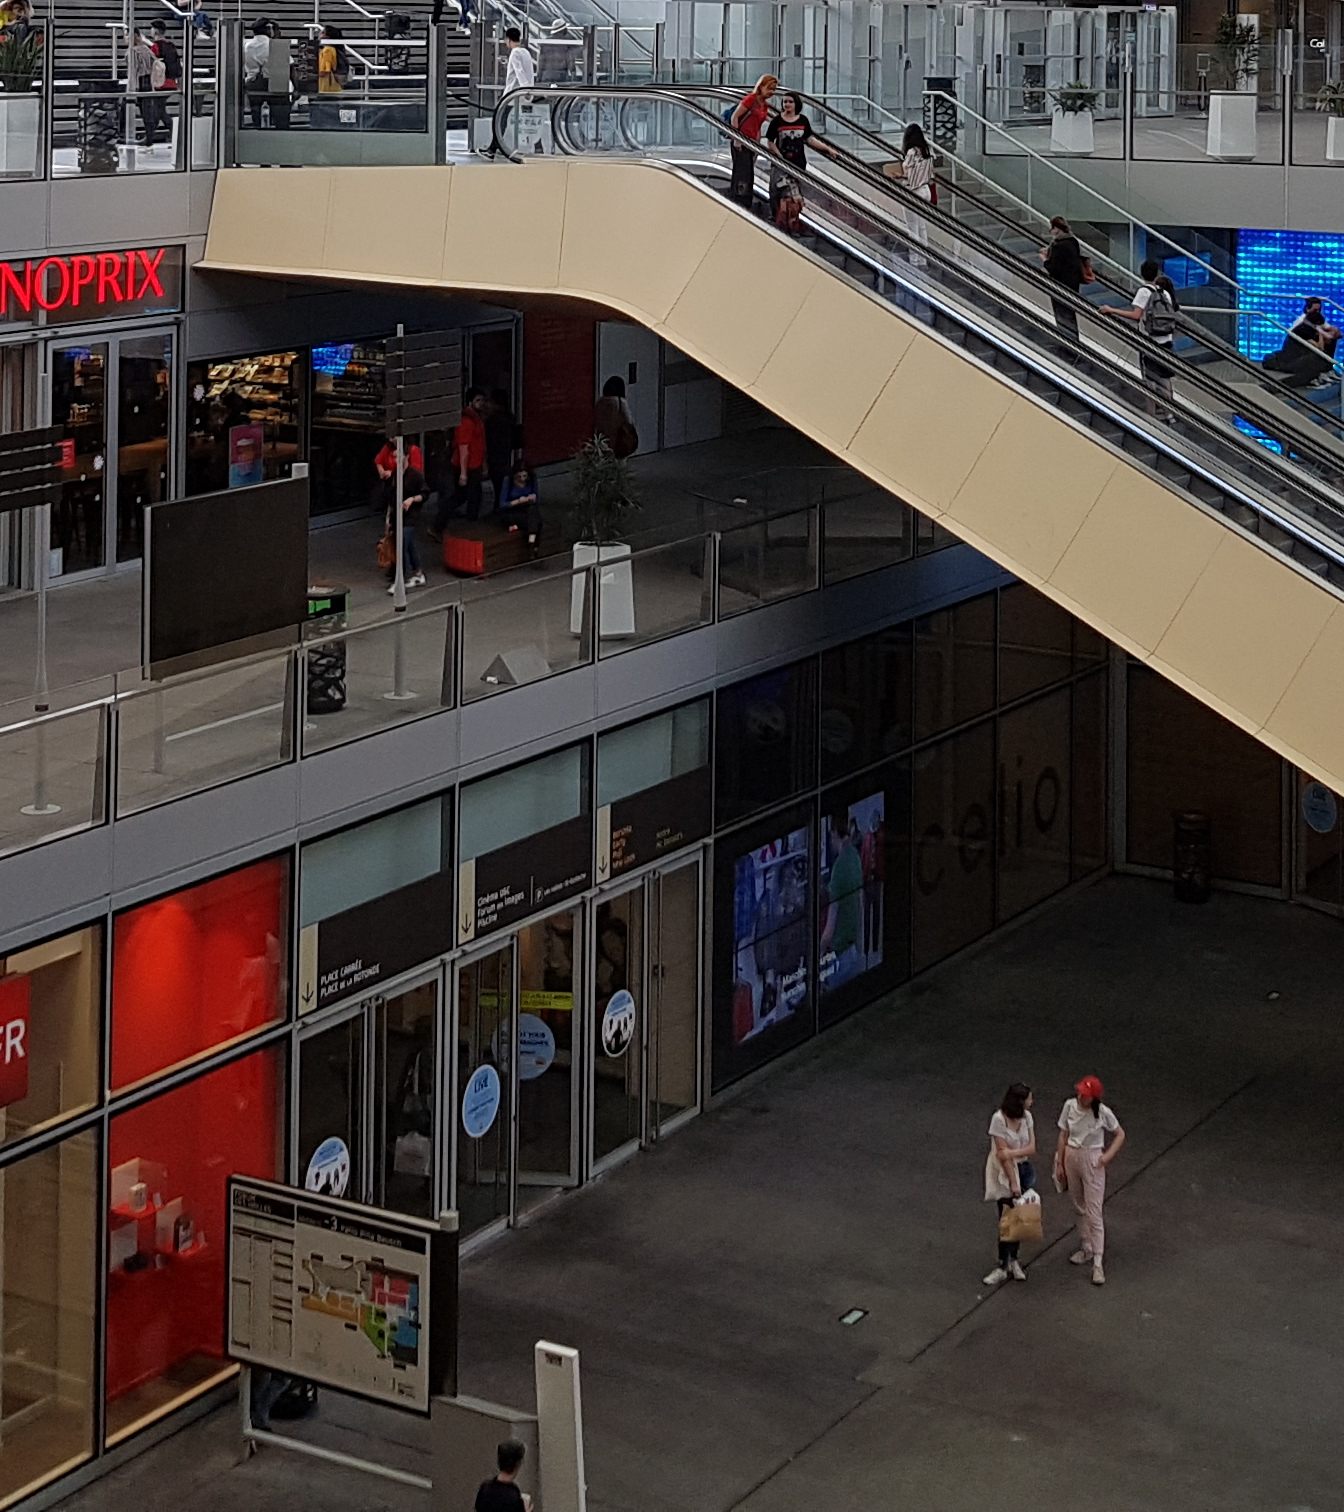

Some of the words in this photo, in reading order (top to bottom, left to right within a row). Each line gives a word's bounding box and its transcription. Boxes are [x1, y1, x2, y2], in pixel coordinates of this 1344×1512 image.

[915, 755, 1060, 896] celio
[320, 969, 339, 986] PLACE
[320, 980, 339, 999] PLACE
